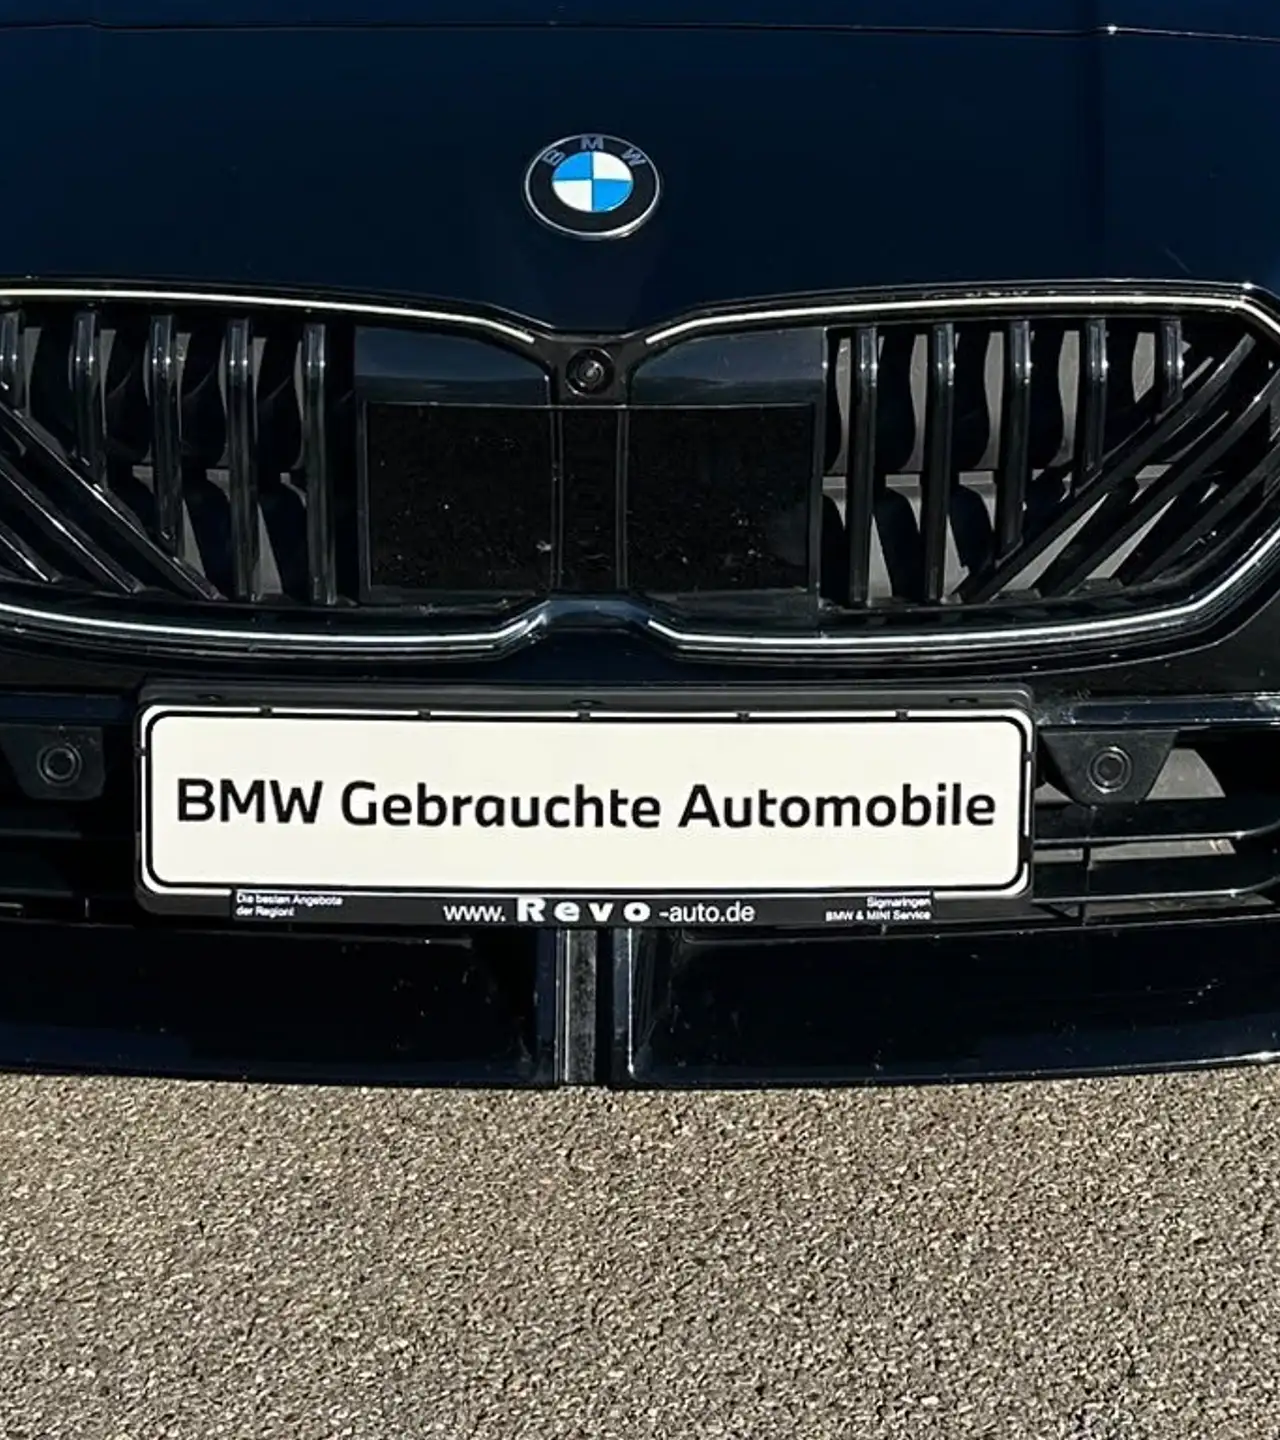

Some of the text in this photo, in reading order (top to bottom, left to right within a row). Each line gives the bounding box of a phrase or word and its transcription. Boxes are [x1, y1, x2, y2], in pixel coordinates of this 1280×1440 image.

[542, 136, 647, 166] BMW
[176, 777, 997, 829] BMW Gebrauchte Automobile
[292, 895, 343, 907] Angebote
[443, 905, 506, 922] www.
[517, 898, 651, 922] Revo
[236, 905, 253, 916] der
[825, 910, 931, 921] BMW & MINI Service
